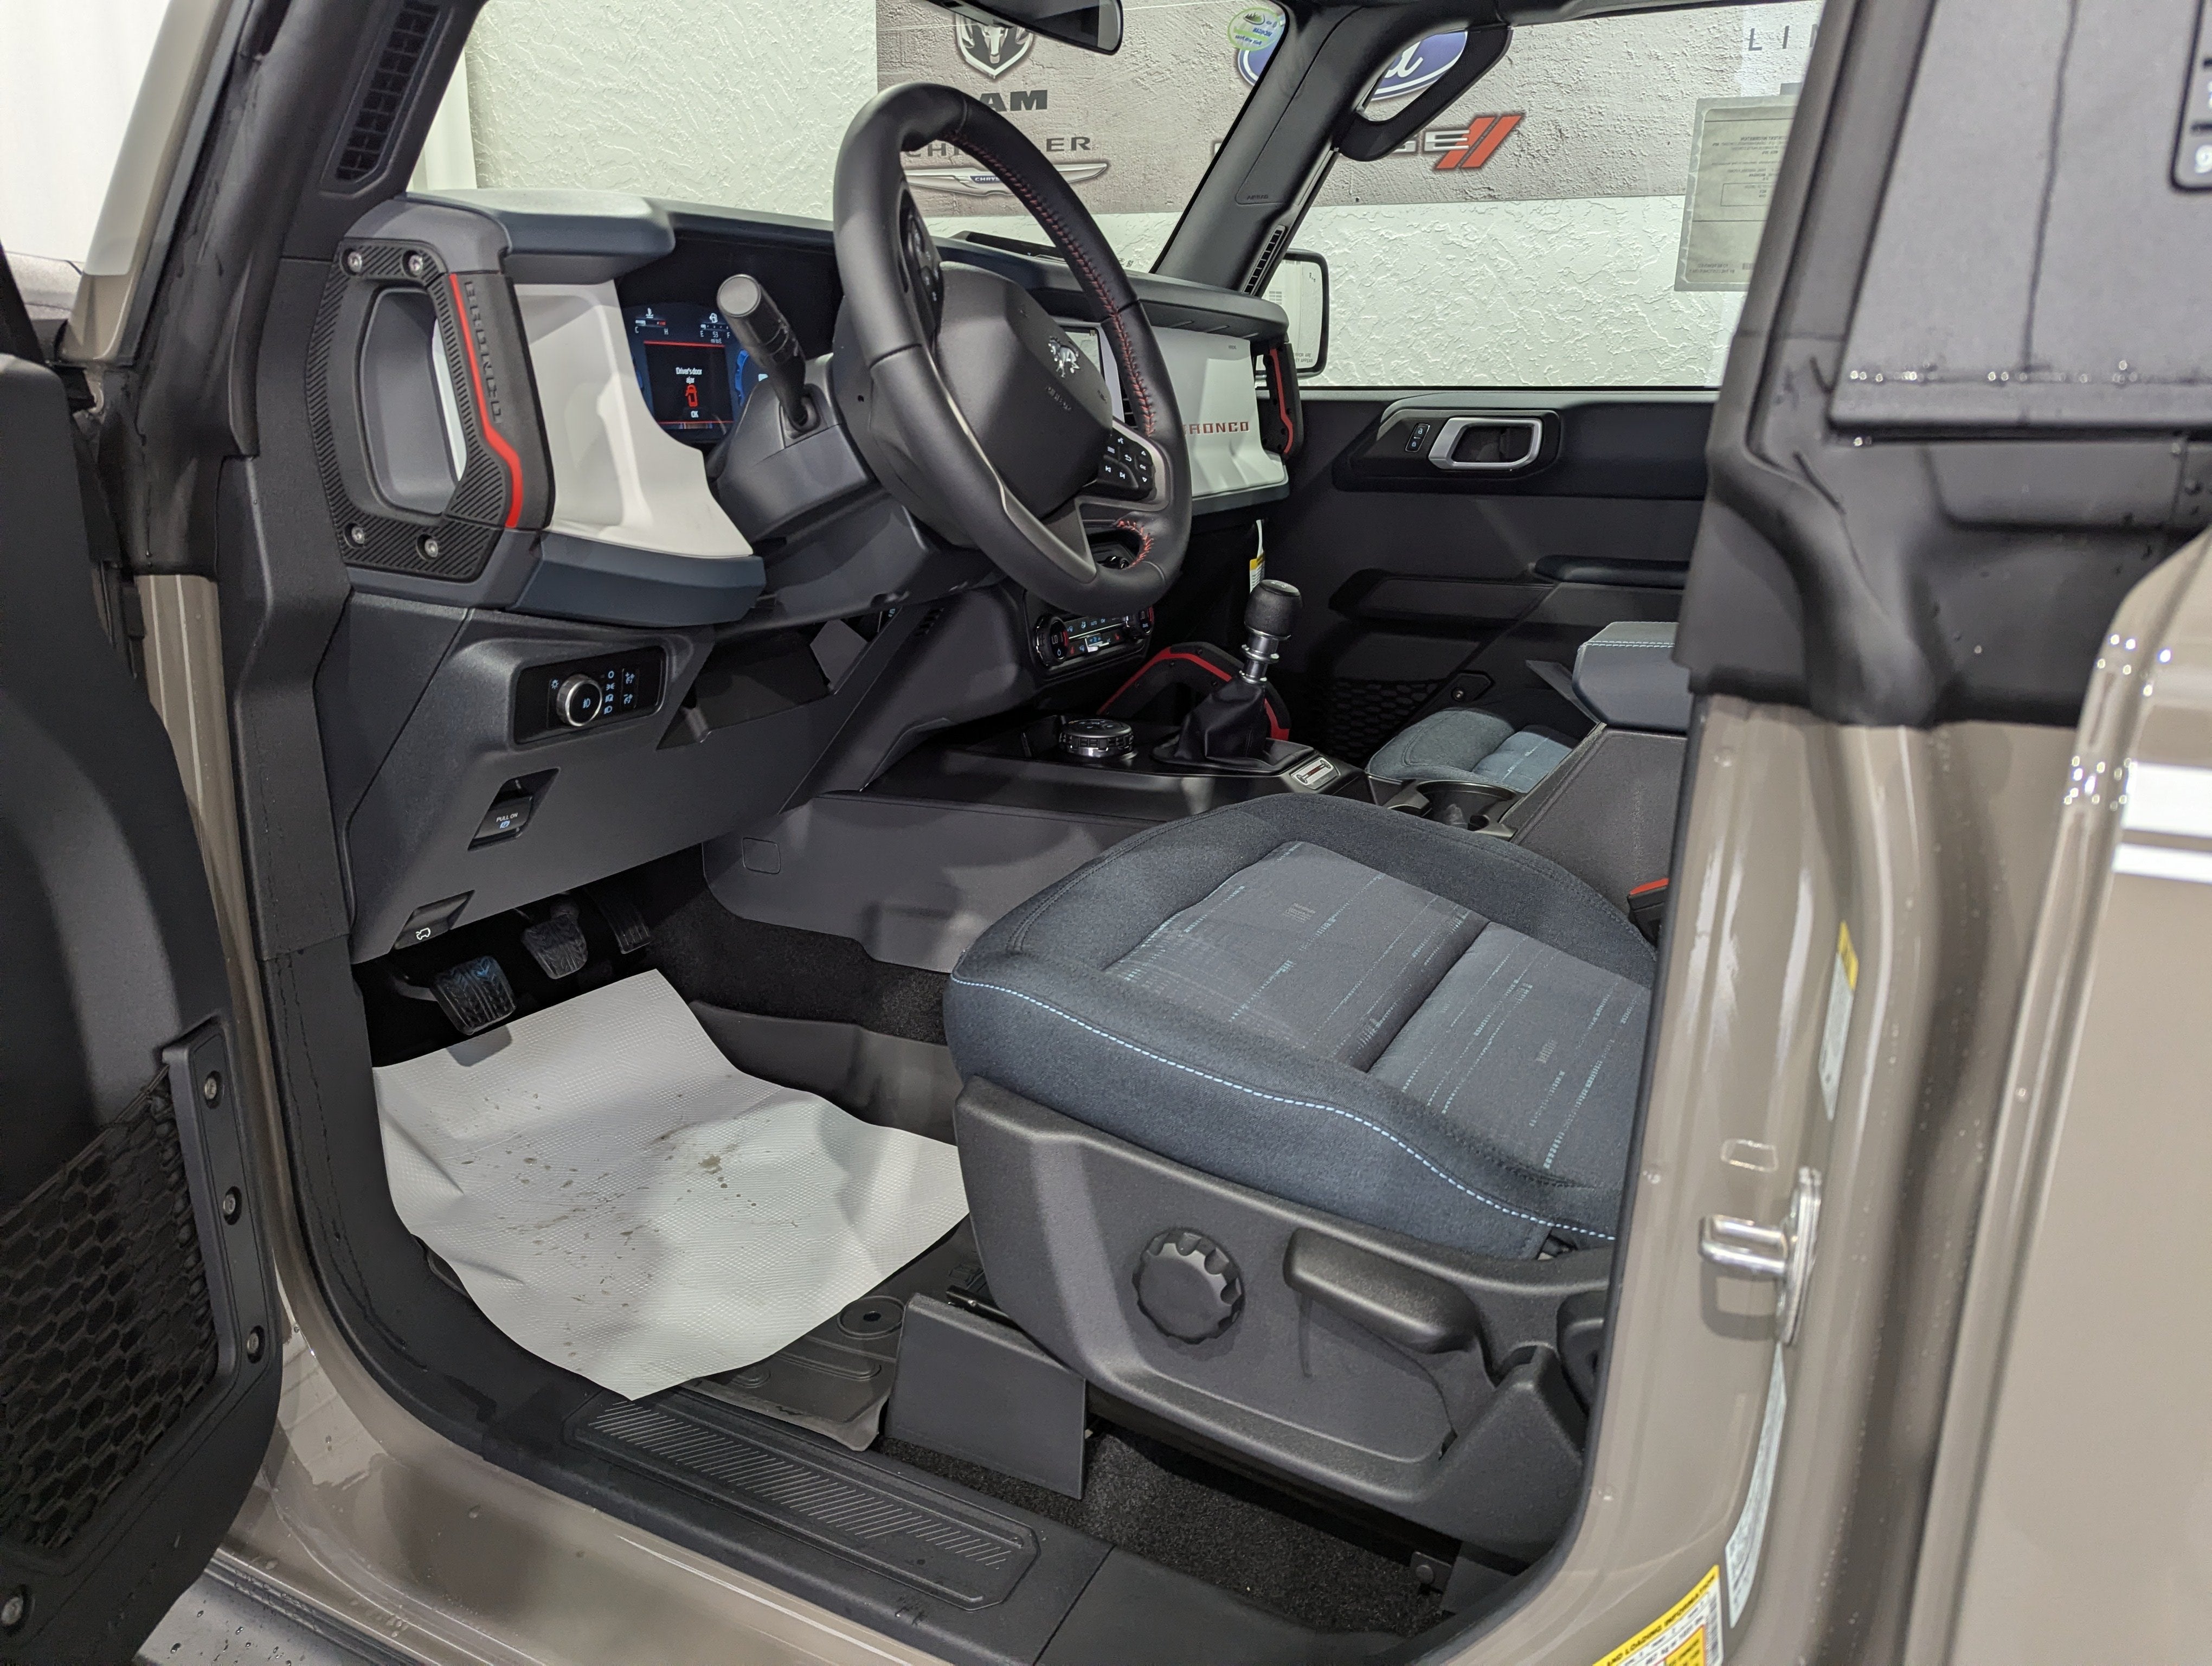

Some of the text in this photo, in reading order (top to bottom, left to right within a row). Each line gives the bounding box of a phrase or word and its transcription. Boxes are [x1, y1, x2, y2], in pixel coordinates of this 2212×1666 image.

[980, 89, 1047, 112] AM
[1182, 421, 1249, 434] RONCO
[1625, 1625, 1662, 1656] LOADING
